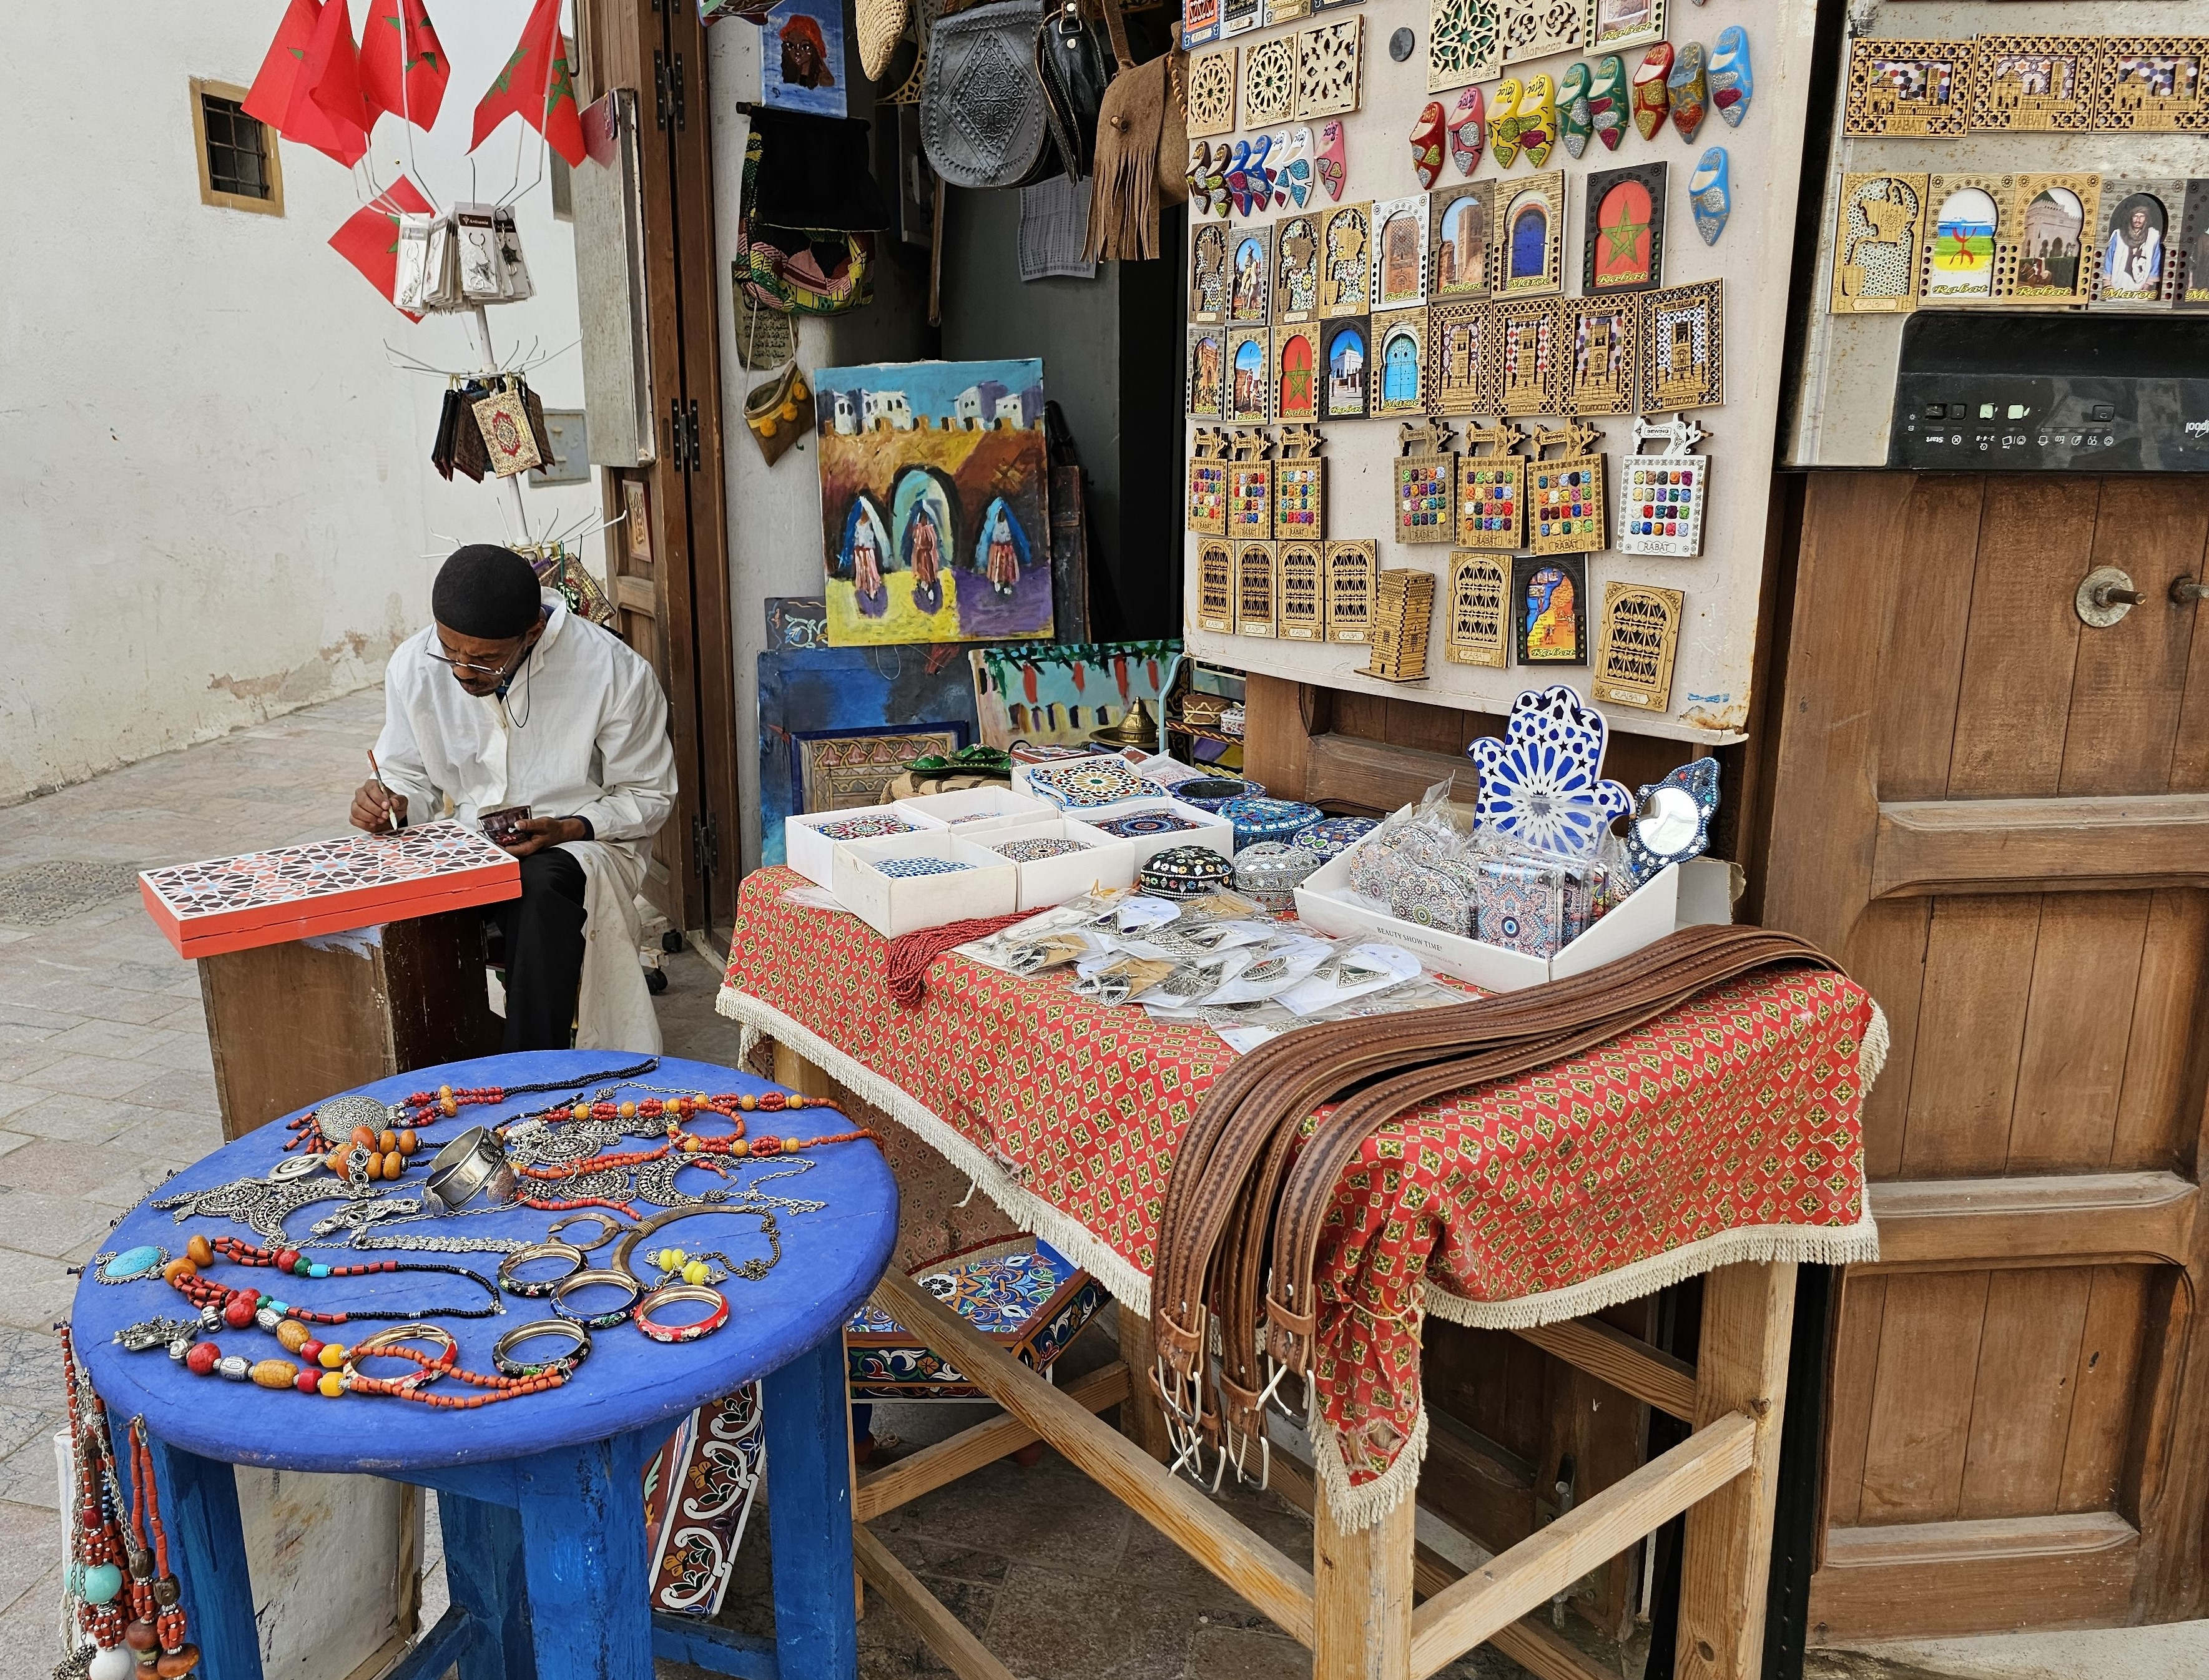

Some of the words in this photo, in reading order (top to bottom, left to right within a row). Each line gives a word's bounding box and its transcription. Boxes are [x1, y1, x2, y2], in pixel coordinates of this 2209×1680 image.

[1600, 21, 1652, 41] Rabat
[1520, 41, 1562, 59] Morocco
[1445, 69, 1481, 84] Oujda
[1497, 82, 1515, 103] Maroc
[1526, 77, 1546, 97] Maroc
[1310, 106, 1339, 117] Morocco
[1889, 118, 1924, 132] RABAT
[1507, 277, 1550, 289] Maroc
[1596, 271, 1648, 284] Rabat
[1442, 281, 1482, 294] Rabat
[1932, 283, 1989, 295] Rabat
[2016, 285, 2072, 297] Rabat
[2101, 287, 2157, 300] Maroc
[1663, 302, 1677, 312] TOUR
[1678, 298, 1696, 309] HASSAN
[1859, 301, 1889, 309] RABAT
[1665, 395, 1696, 405] morocco
[1510, 404, 1537, 412] morocco
[1579, 403, 1610, 412] morocco
[1545, 433, 1565, 441] SEWING
[1477, 536, 1498, 545] RABAT
[1555, 540, 1579, 549] RABAT
[1644, 542, 1669, 552] RABAT
[1530, 647, 1576, 658] Rabat
[1615, 692, 1643, 702] RABAT
[1377, 926, 1402, 939] BEAUTY
[1403, 935, 1423, 945] SHOW
[1424, 940, 1442, 951] TIME!
